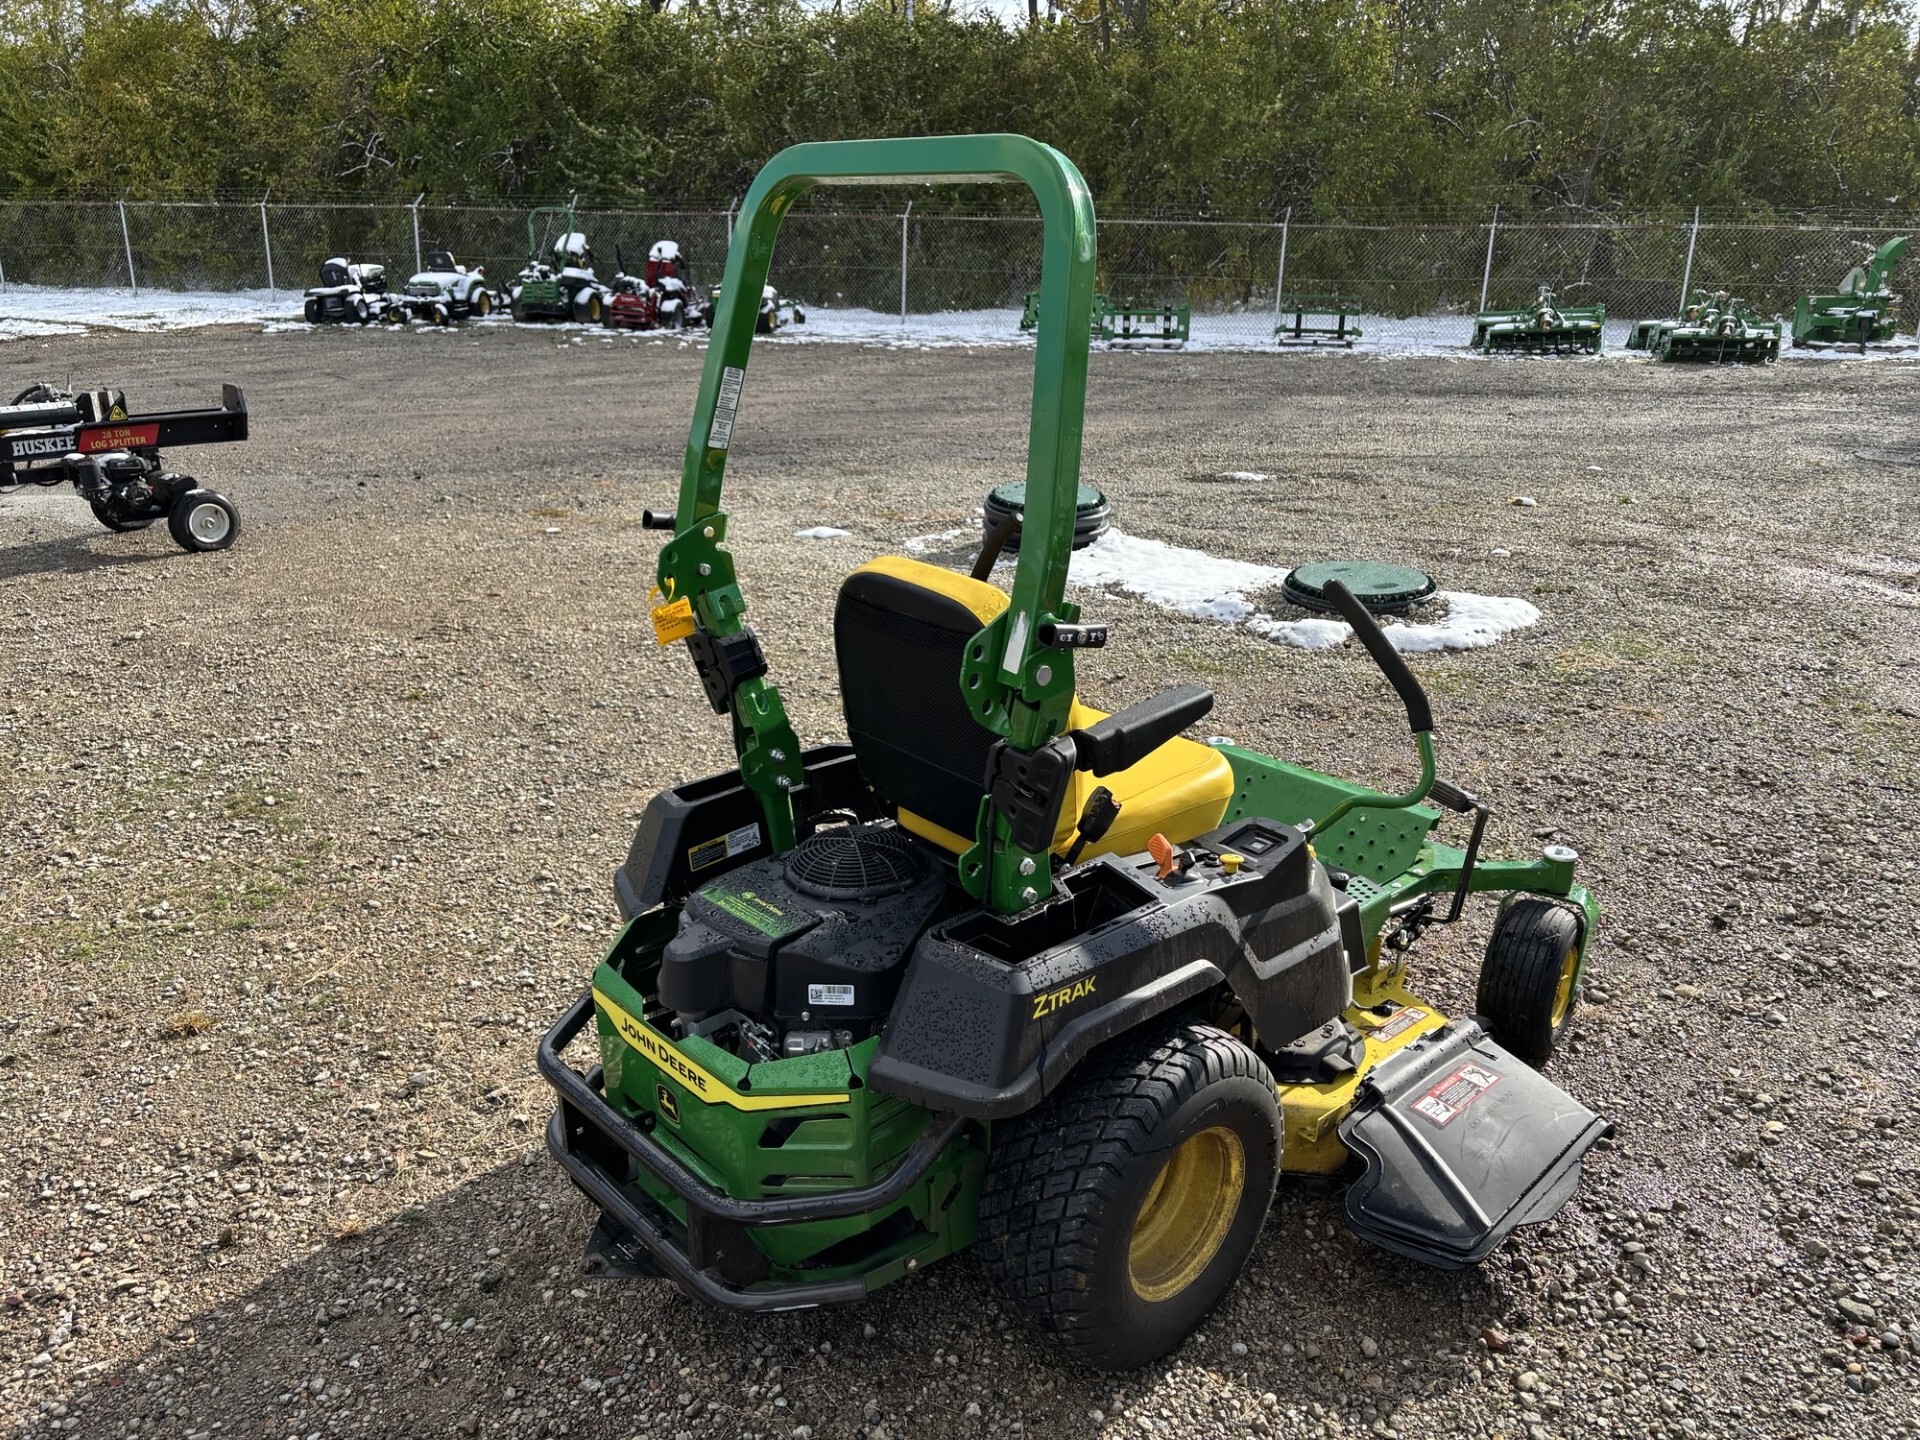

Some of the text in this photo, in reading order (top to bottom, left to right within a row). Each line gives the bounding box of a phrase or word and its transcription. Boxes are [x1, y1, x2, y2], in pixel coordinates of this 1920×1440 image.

[91, 436, 147, 449] LOG SPLITTER
[101, 429, 131, 439] 28 TON
[12, 436, 76, 456] HUSKEE
[1033, 975, 1097, 1020] ZTRAK
[621, 1017, 708, 1092] JOHN DEERE
